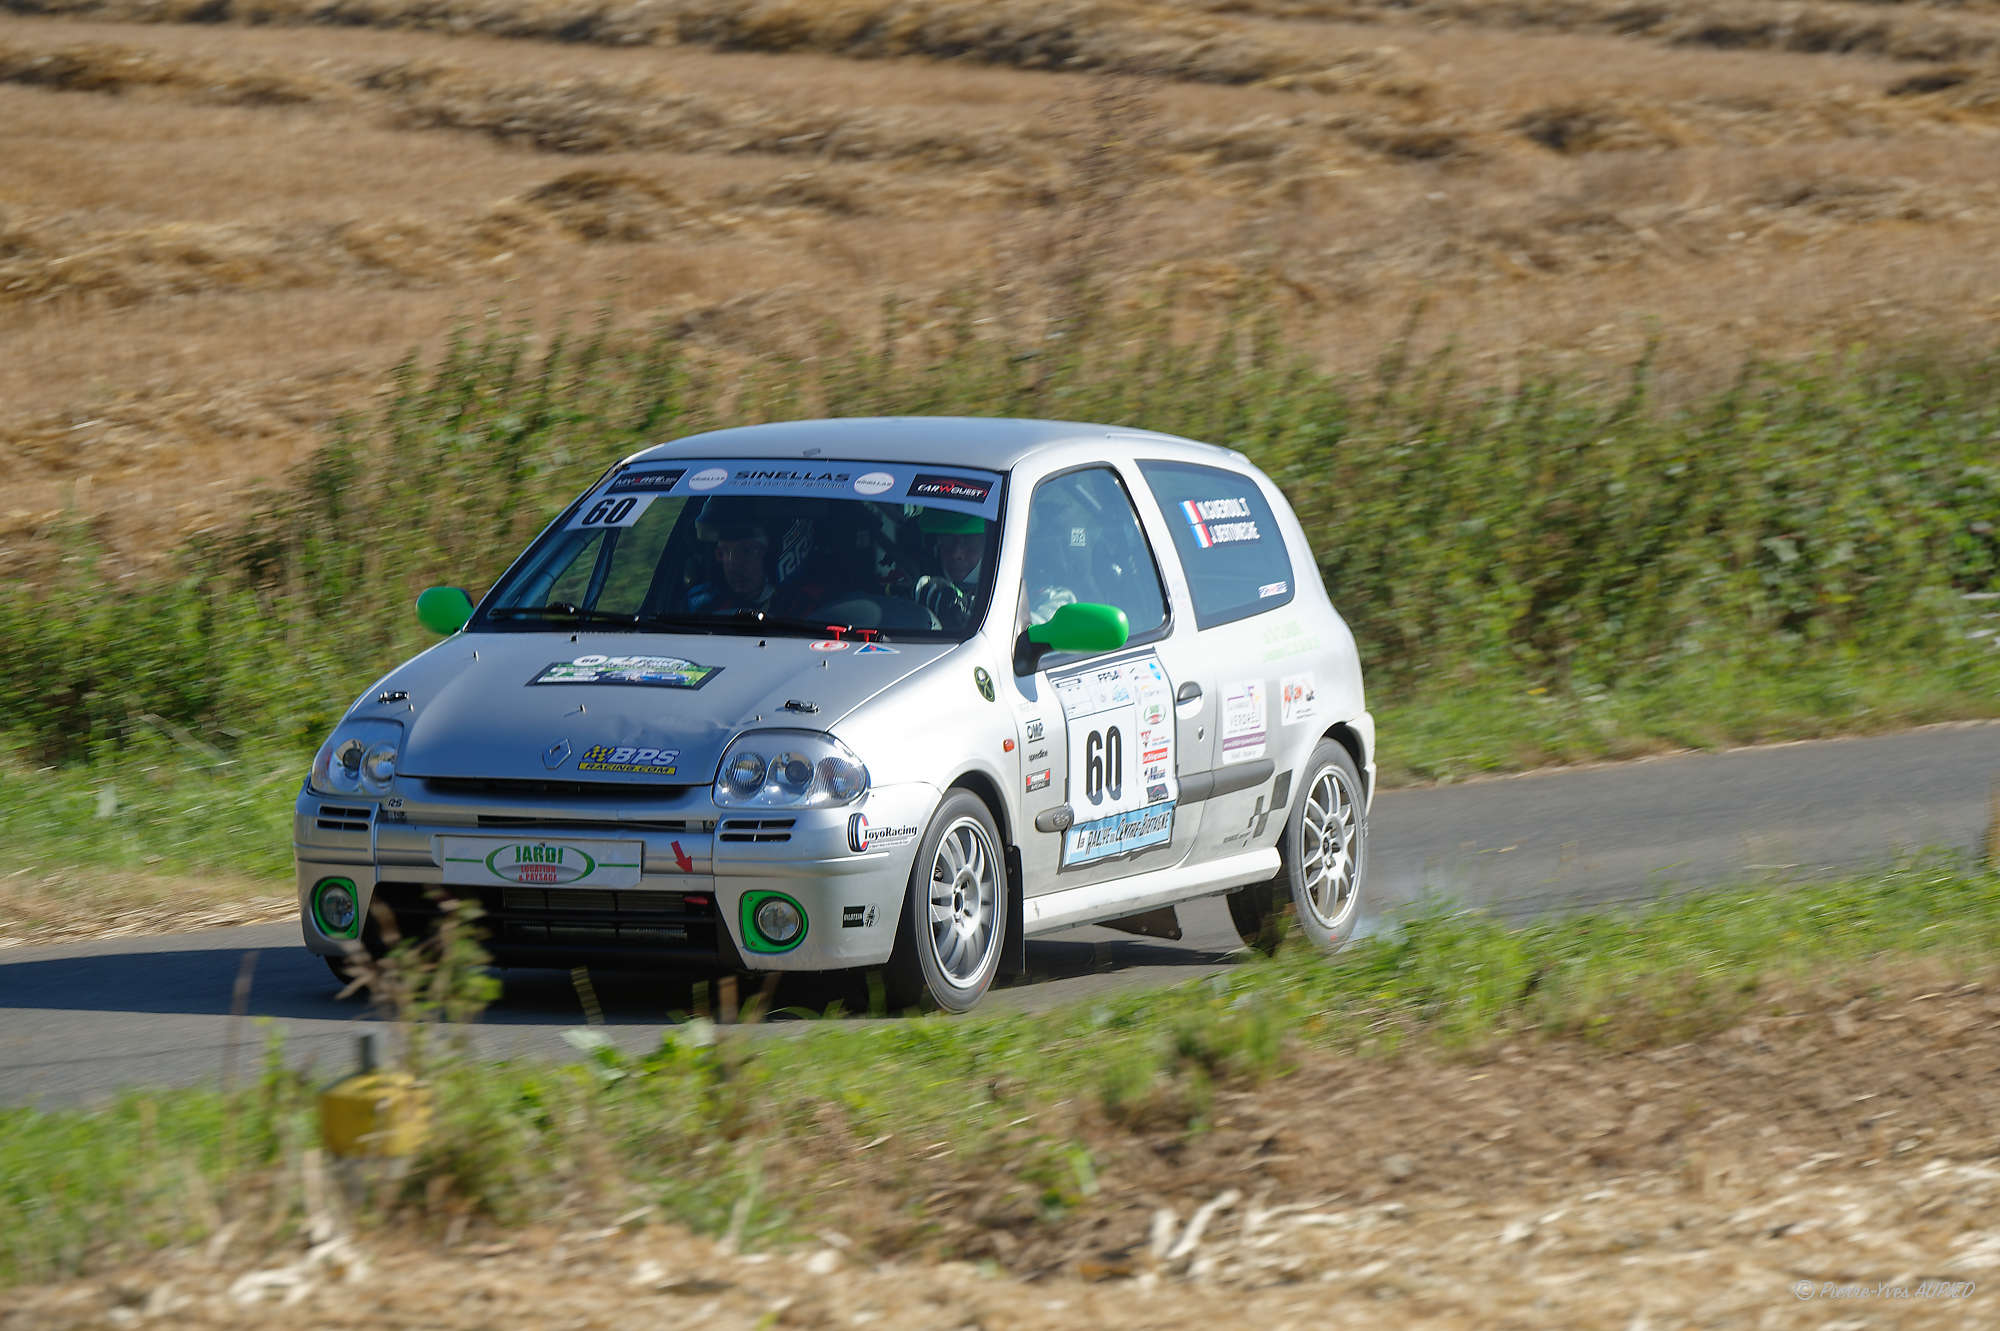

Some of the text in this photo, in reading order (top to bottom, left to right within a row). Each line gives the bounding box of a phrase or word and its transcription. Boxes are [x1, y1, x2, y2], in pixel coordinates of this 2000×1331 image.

[734, 471, 850, 481] SINELLAS
[581, 498, 638, 525] 60
[608, 747, 680, 765] BPS
[1086, 725, 1122, 805] 60
[515, 846, 564, 864] JARDI
